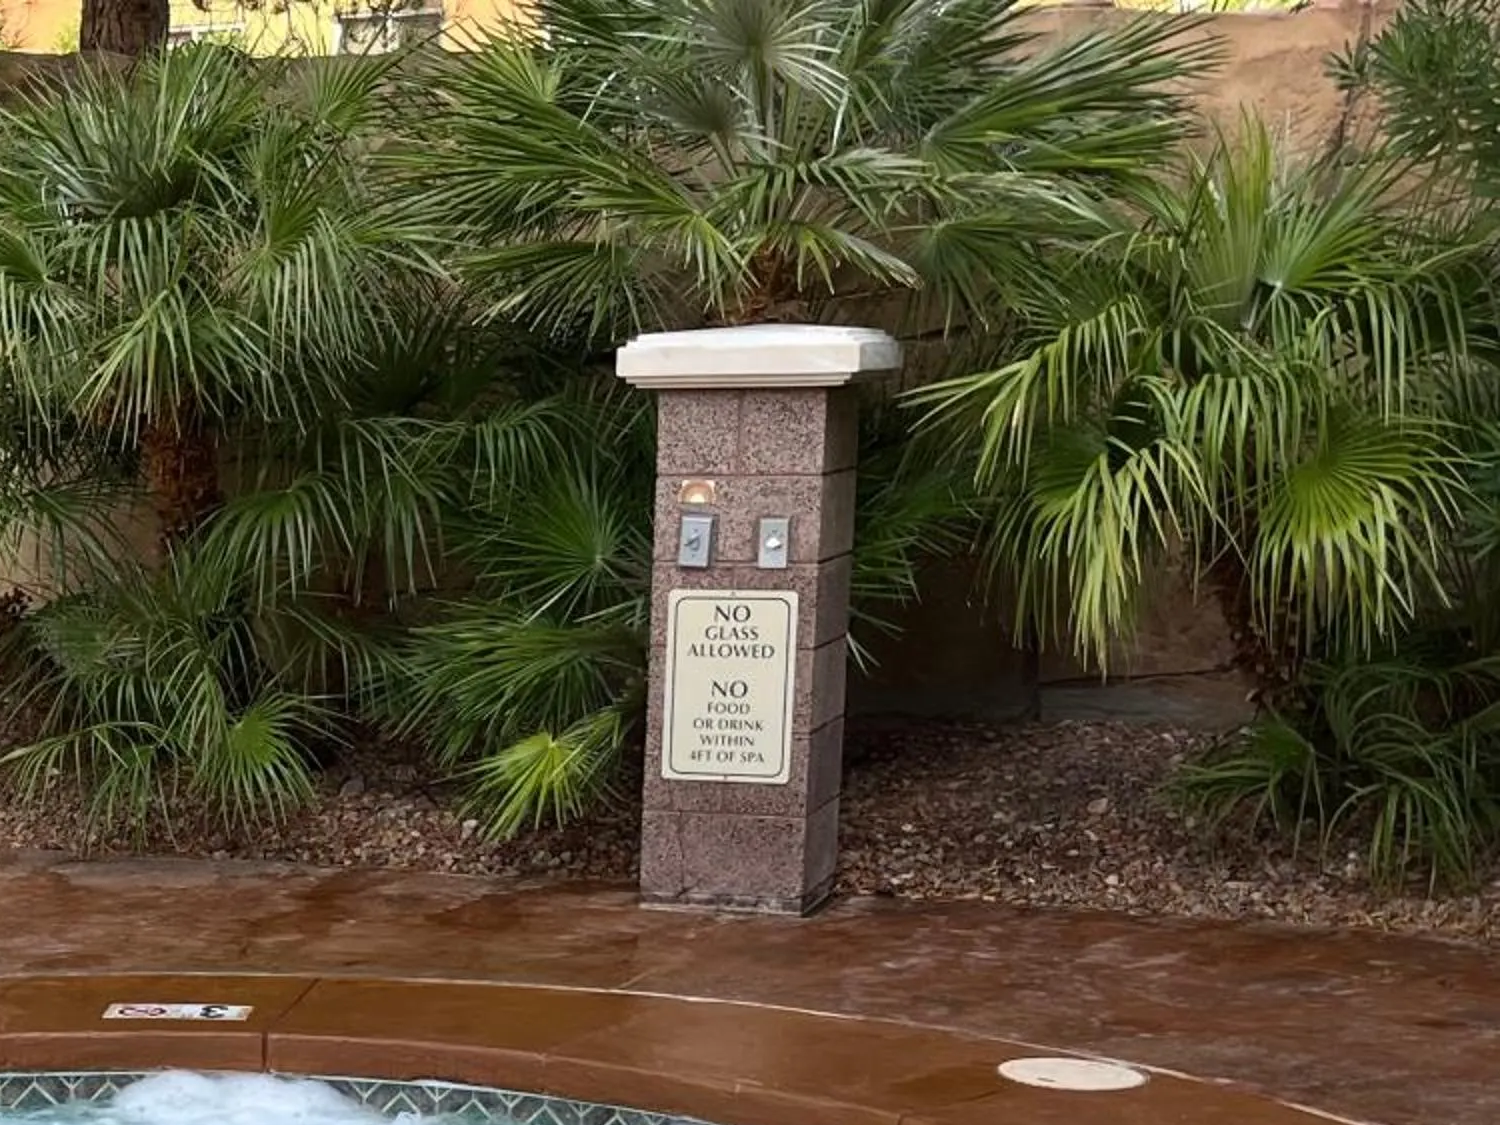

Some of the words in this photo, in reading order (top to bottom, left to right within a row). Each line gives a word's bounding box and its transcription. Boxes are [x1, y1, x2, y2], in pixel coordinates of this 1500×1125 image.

[713, 605, 751, 622] NO
[705, 626, 759, 640] GLASS
[687, 643, 775, 660] ALLOWED
[711, 680, 748, 698] NO
[707, 703, 750, 715] FOOD
[693, 718, 714, 730] OR
[718, 719, 764, 731] DRINK
[700, 734, 755, 747] WITHIN
[689, 750, 712, 763] 4FT
[716, 750, 737, 763] OF
[740, 751, 765, 764] SPA
